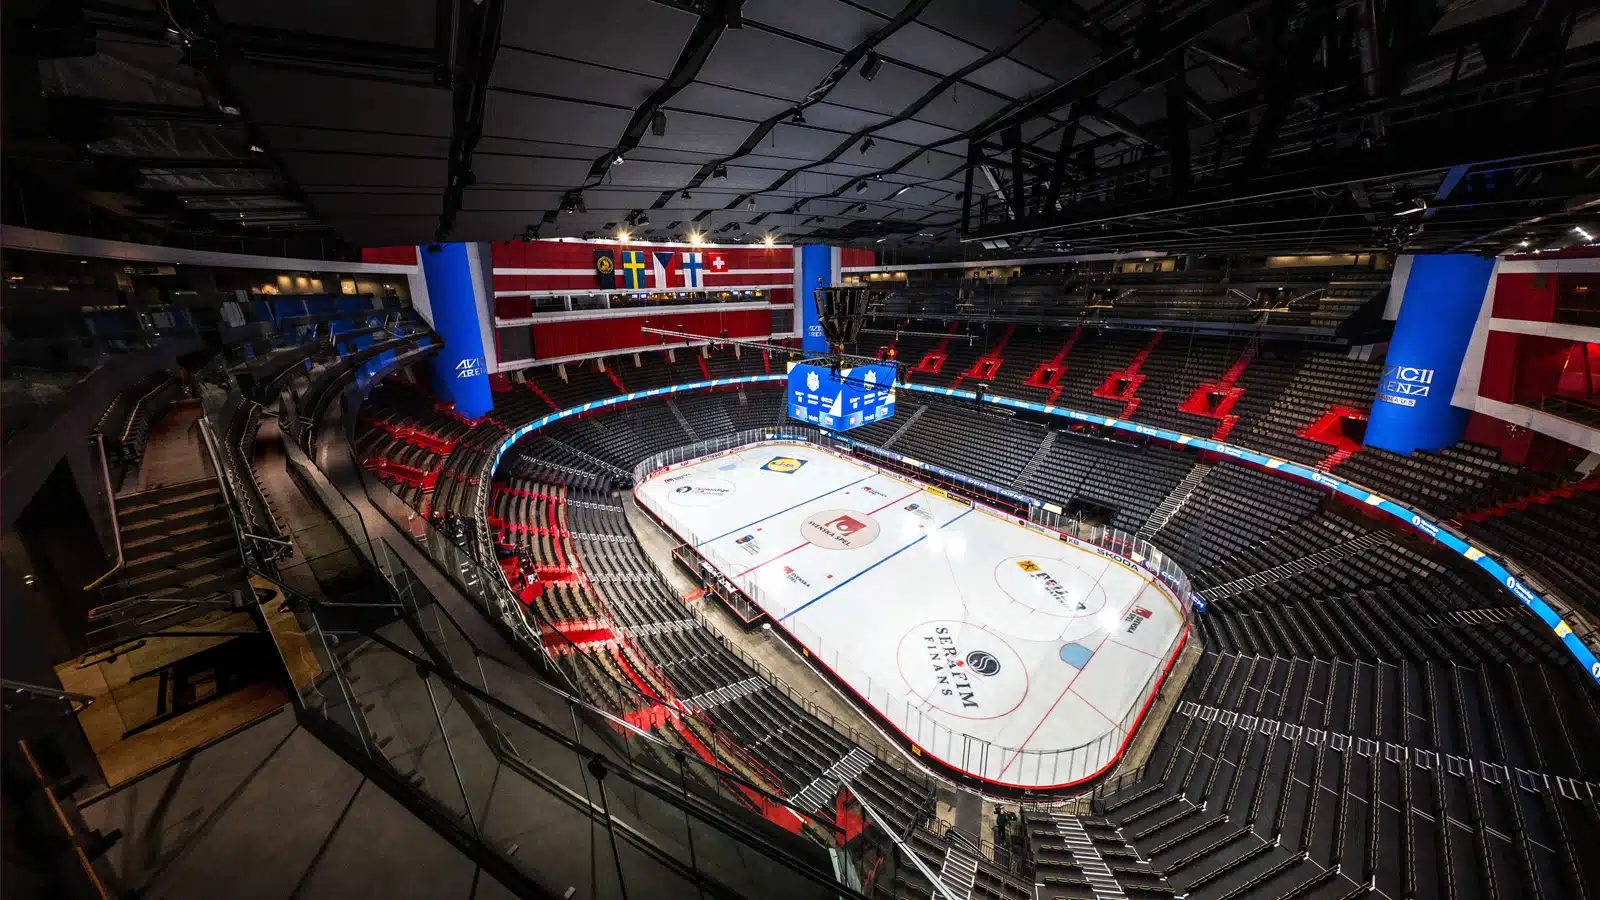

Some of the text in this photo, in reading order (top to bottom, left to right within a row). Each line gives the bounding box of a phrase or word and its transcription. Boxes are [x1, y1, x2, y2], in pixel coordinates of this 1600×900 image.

[707, 451, 724, 460] TISSOT
[808, 520, 852, 547] SVENSKA SPEL
[791, 572, 811, 588] SVENSKA
[1126, 615, 1144, 634] SVENSKA
[924, 636, 953, 696] FINANS
